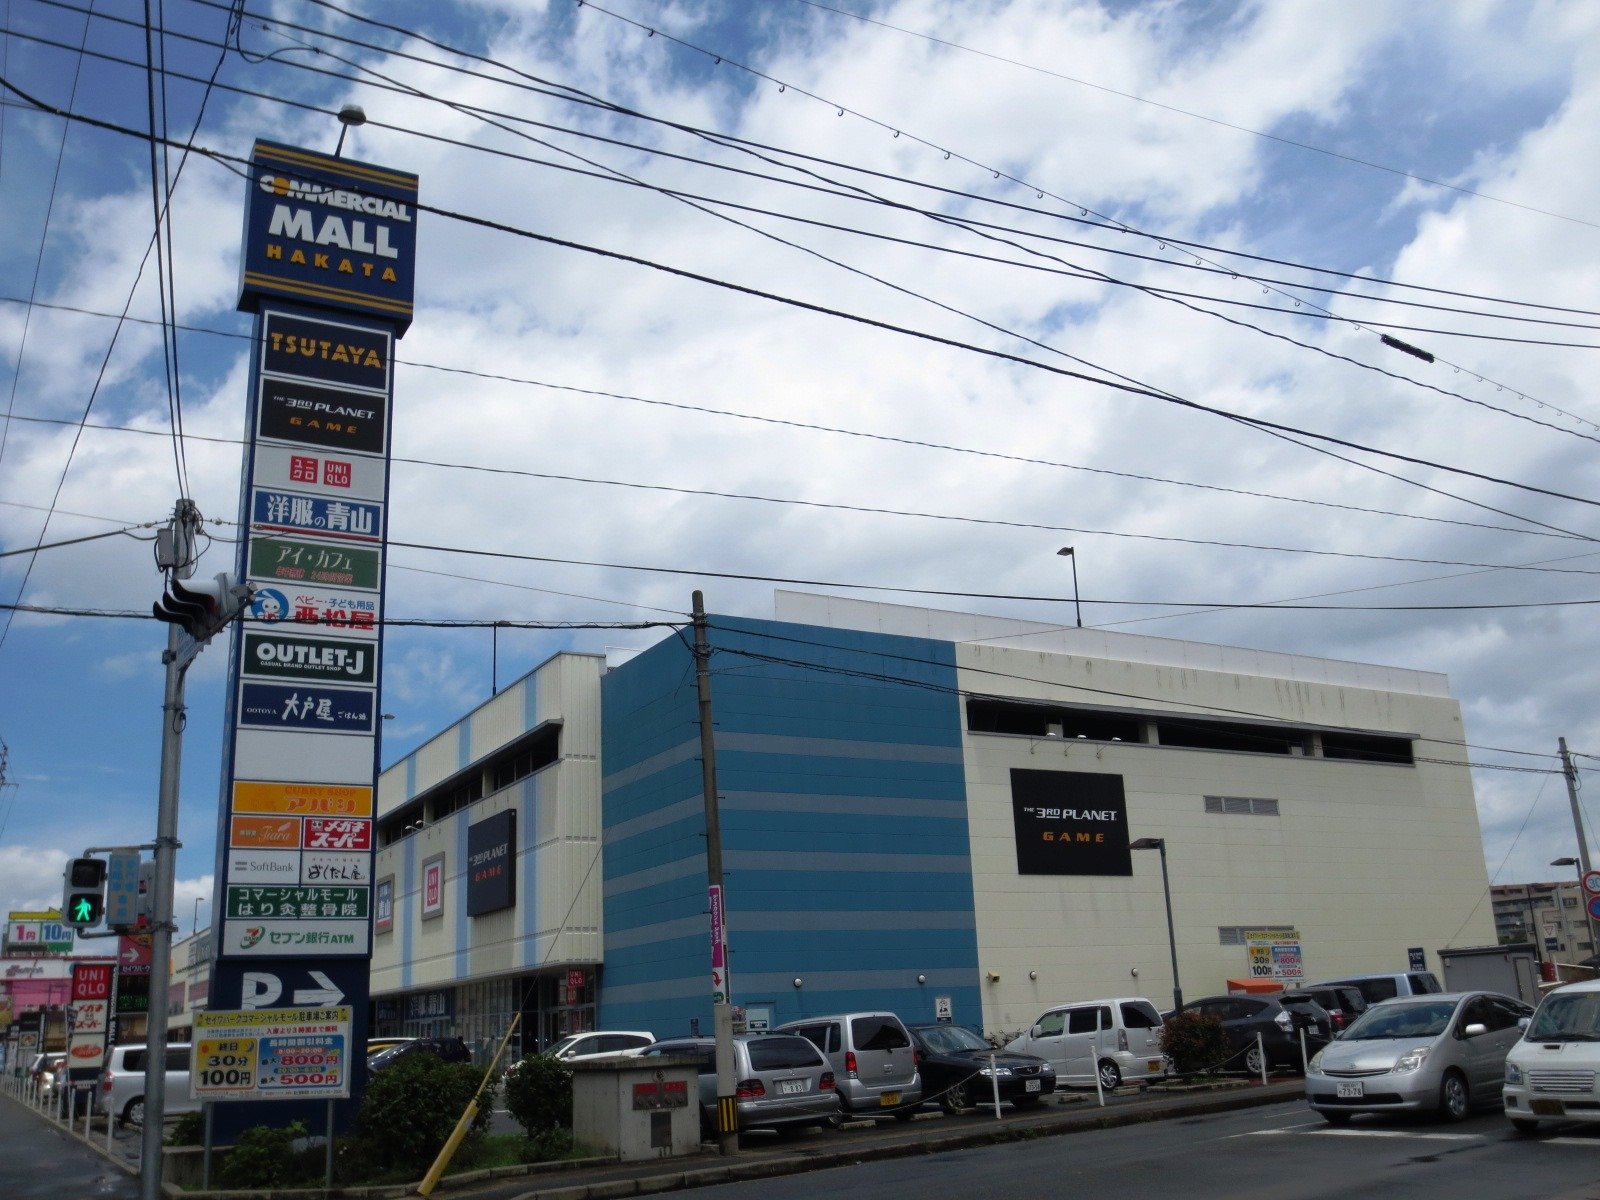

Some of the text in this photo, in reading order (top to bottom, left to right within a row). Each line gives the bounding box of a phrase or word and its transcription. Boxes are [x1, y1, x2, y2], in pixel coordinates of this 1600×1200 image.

[259, 175, 412, 222] COMMERCIAL
[268, 204, 398, 259] MALL
[266, 243, 397, 282] HAKATA
[271, 332, 381, 368] TSUTAYA
[314, 402, 376, 420] PLANET
[289, 416, 357, 434] GAME
[326, 463, 347, 474] UNI
[326, 474, 348, 485] QLO
[267, 494, 373, 534] 洋服の青山
[256, 642, 364, 675] OUTLET-J
[1035, 807, 1061, 819] 3RD
[1062, 809, 1118, 821] PLANET
[324, 820, 365, 833] メガネ
[310, 832, 365, 848] スーパー
[1042, 831, 1105, 843] GAME
[249, 861, 294, 873] SoftBank
[238, 888, 358, 902] コマーシャルモール
[238, 903, 358, 916] はり灸整骨院
[44, 923, 72, 941] 10円
[270, 931, 354, 945] セブン銀行ATM
[78, 969, 104, 981] UNI
[77, 983, 106, 995] QLO
[241, 971, 283, 1011] P
[207, 1055, 248, 1067] 30分
[280, 1055, 338, 1066] 800円
[200, 1069, 251, 1086] 100円
[280, 1073, 338, 1085] 500円
